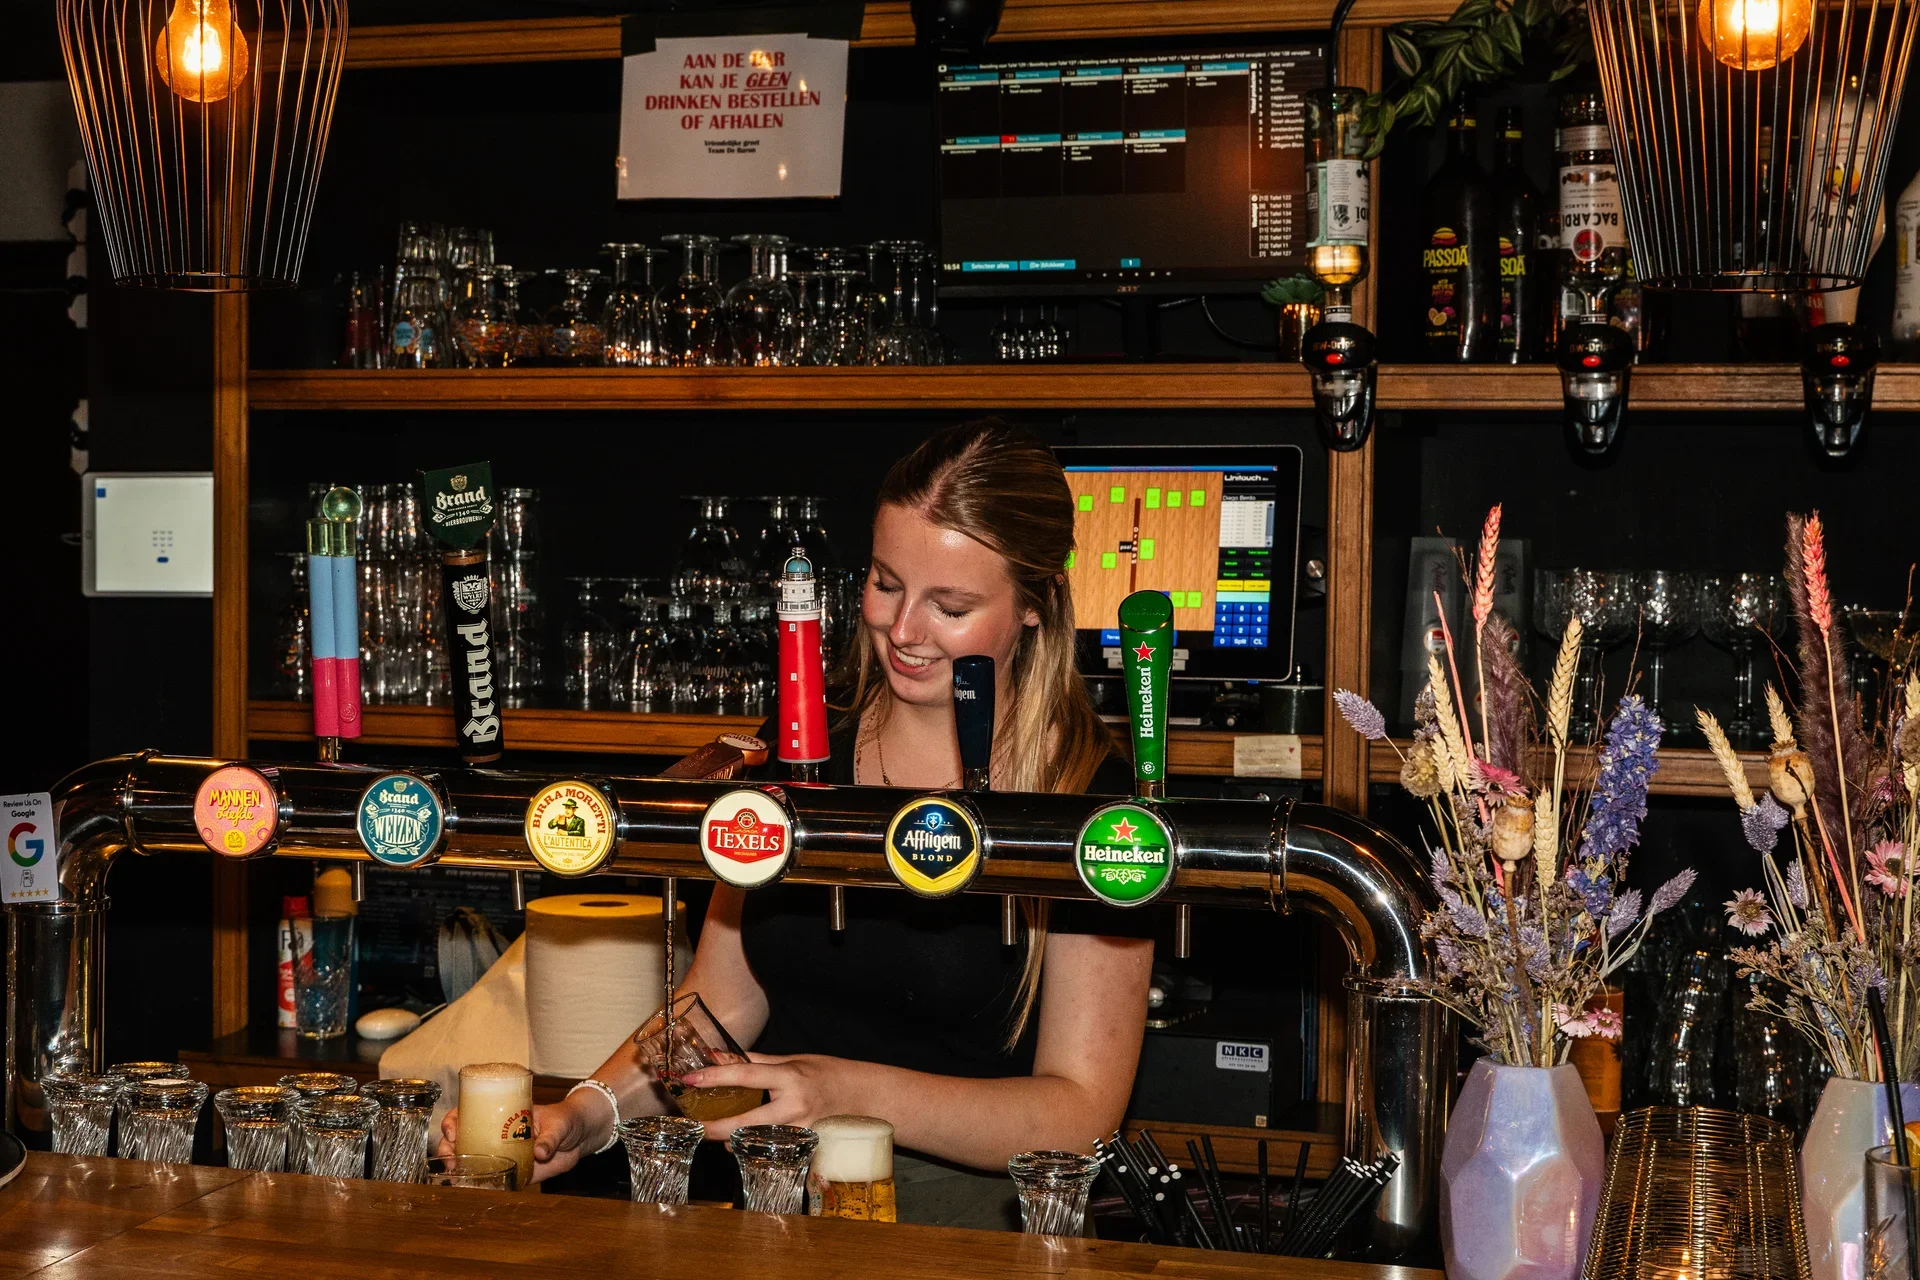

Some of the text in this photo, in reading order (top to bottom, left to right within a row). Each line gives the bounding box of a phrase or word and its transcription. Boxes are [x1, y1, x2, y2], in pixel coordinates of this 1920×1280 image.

[683, 51, 785, 70] AAN DE BAR
[680, 71, 792, 90] KAN JE GEEN
[645, 91, 821, 111] DRINKEN BESTELLEN
[681, 113, 784, 130] OF AFHALEN
[704, 139, 742, 147] Vriendelijke
[1224, 474, 1262, 482] Unitouch
[436, 486, 487, 511] Brand
[445, 515, 483, 527] BIERBROUWERIJ
[456, 617, 501, 744] Brand
[1140, 666, 1154, 738] Heineken
[3, 800, 24, 808] Review
[32, 798, 42, 806] On
[209, 789, 261, 807] MANNEN
[379, 789, 419, 805] Brand
[11, 809, 36, 818] Google
[216, 804, 254, 827] Liefde
[532, 788, 607, 834] BIRRA MORETTI
[374, 814, 421, 845] WEIZEN
[543, 835, 593, 850] L'AUTENTICA
[901, 830, 962, 852] Affligem
[912, 853, 953, 862] BLOND
[1084, 845, 1164, 864] Heineken
[1224, 1046, 1260, 1057] NKC
[501, 1112, 520, 1140] BIRRA
